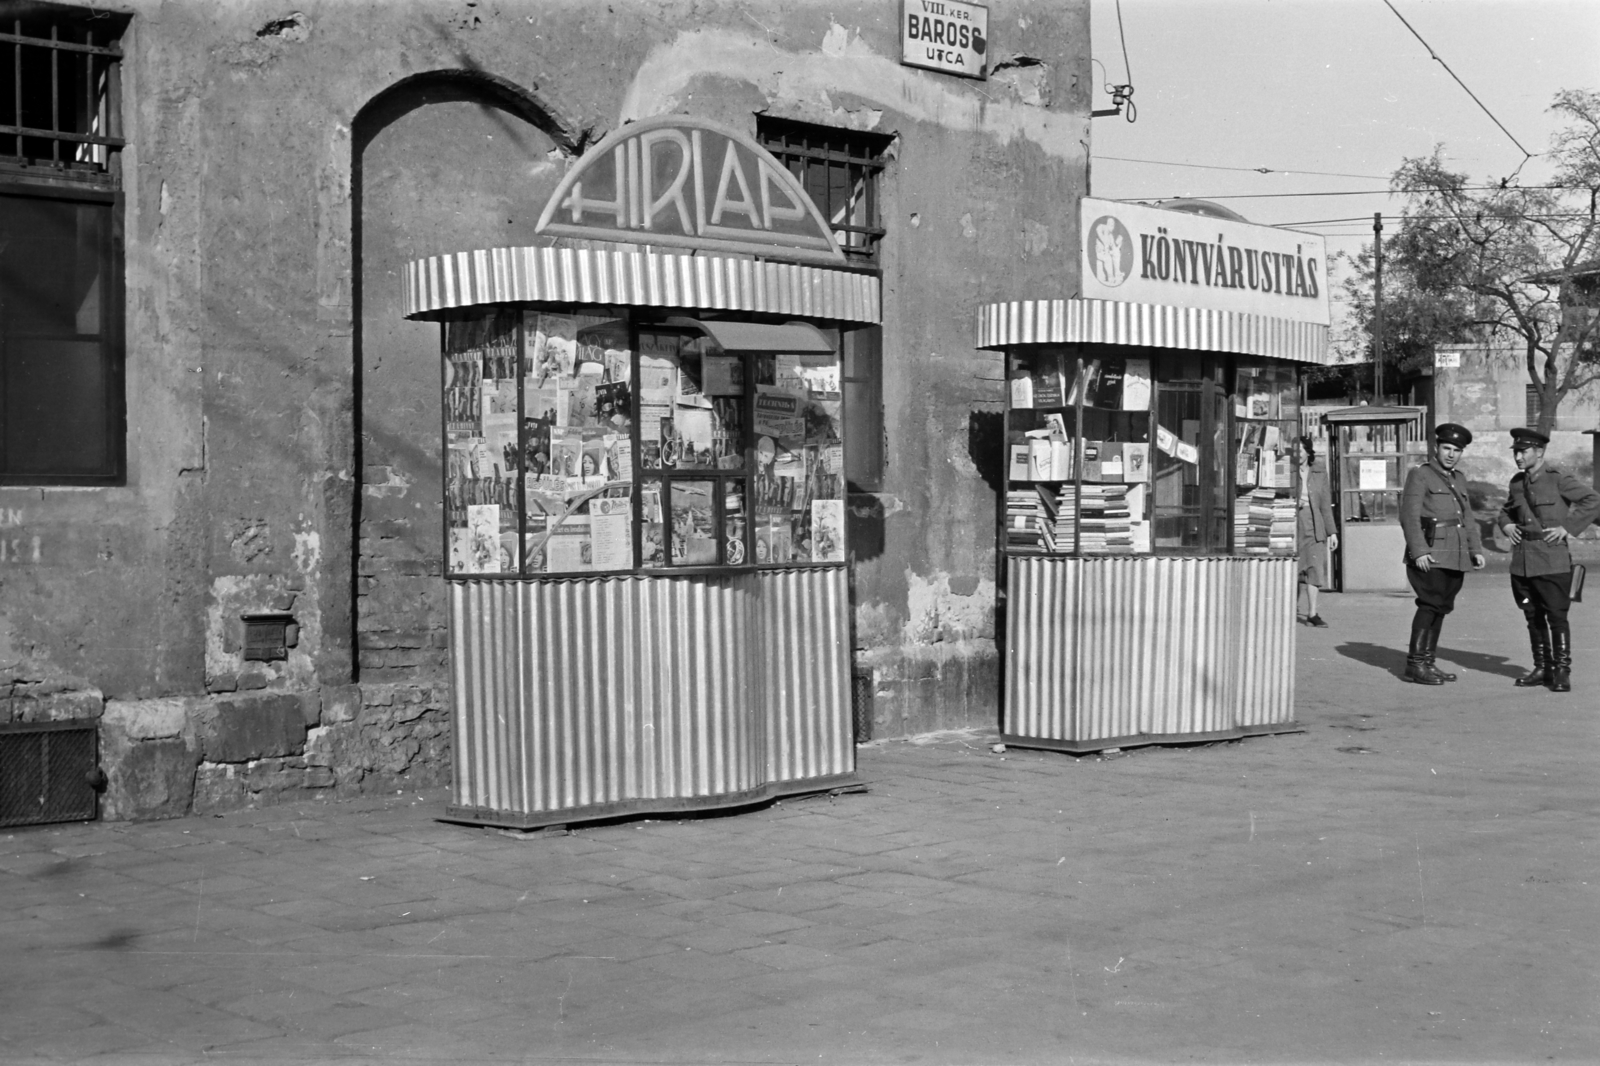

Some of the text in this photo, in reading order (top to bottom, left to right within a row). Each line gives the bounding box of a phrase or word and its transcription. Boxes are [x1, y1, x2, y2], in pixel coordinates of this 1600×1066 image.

[922, 1, 972, 21] VIII. KER.
[927, 47, 964, 66] UTCA
[561, 128, 814, 240] HIRLAP
[1140, 227, 1319, 299] KÖNYVÁRUSITÁS
